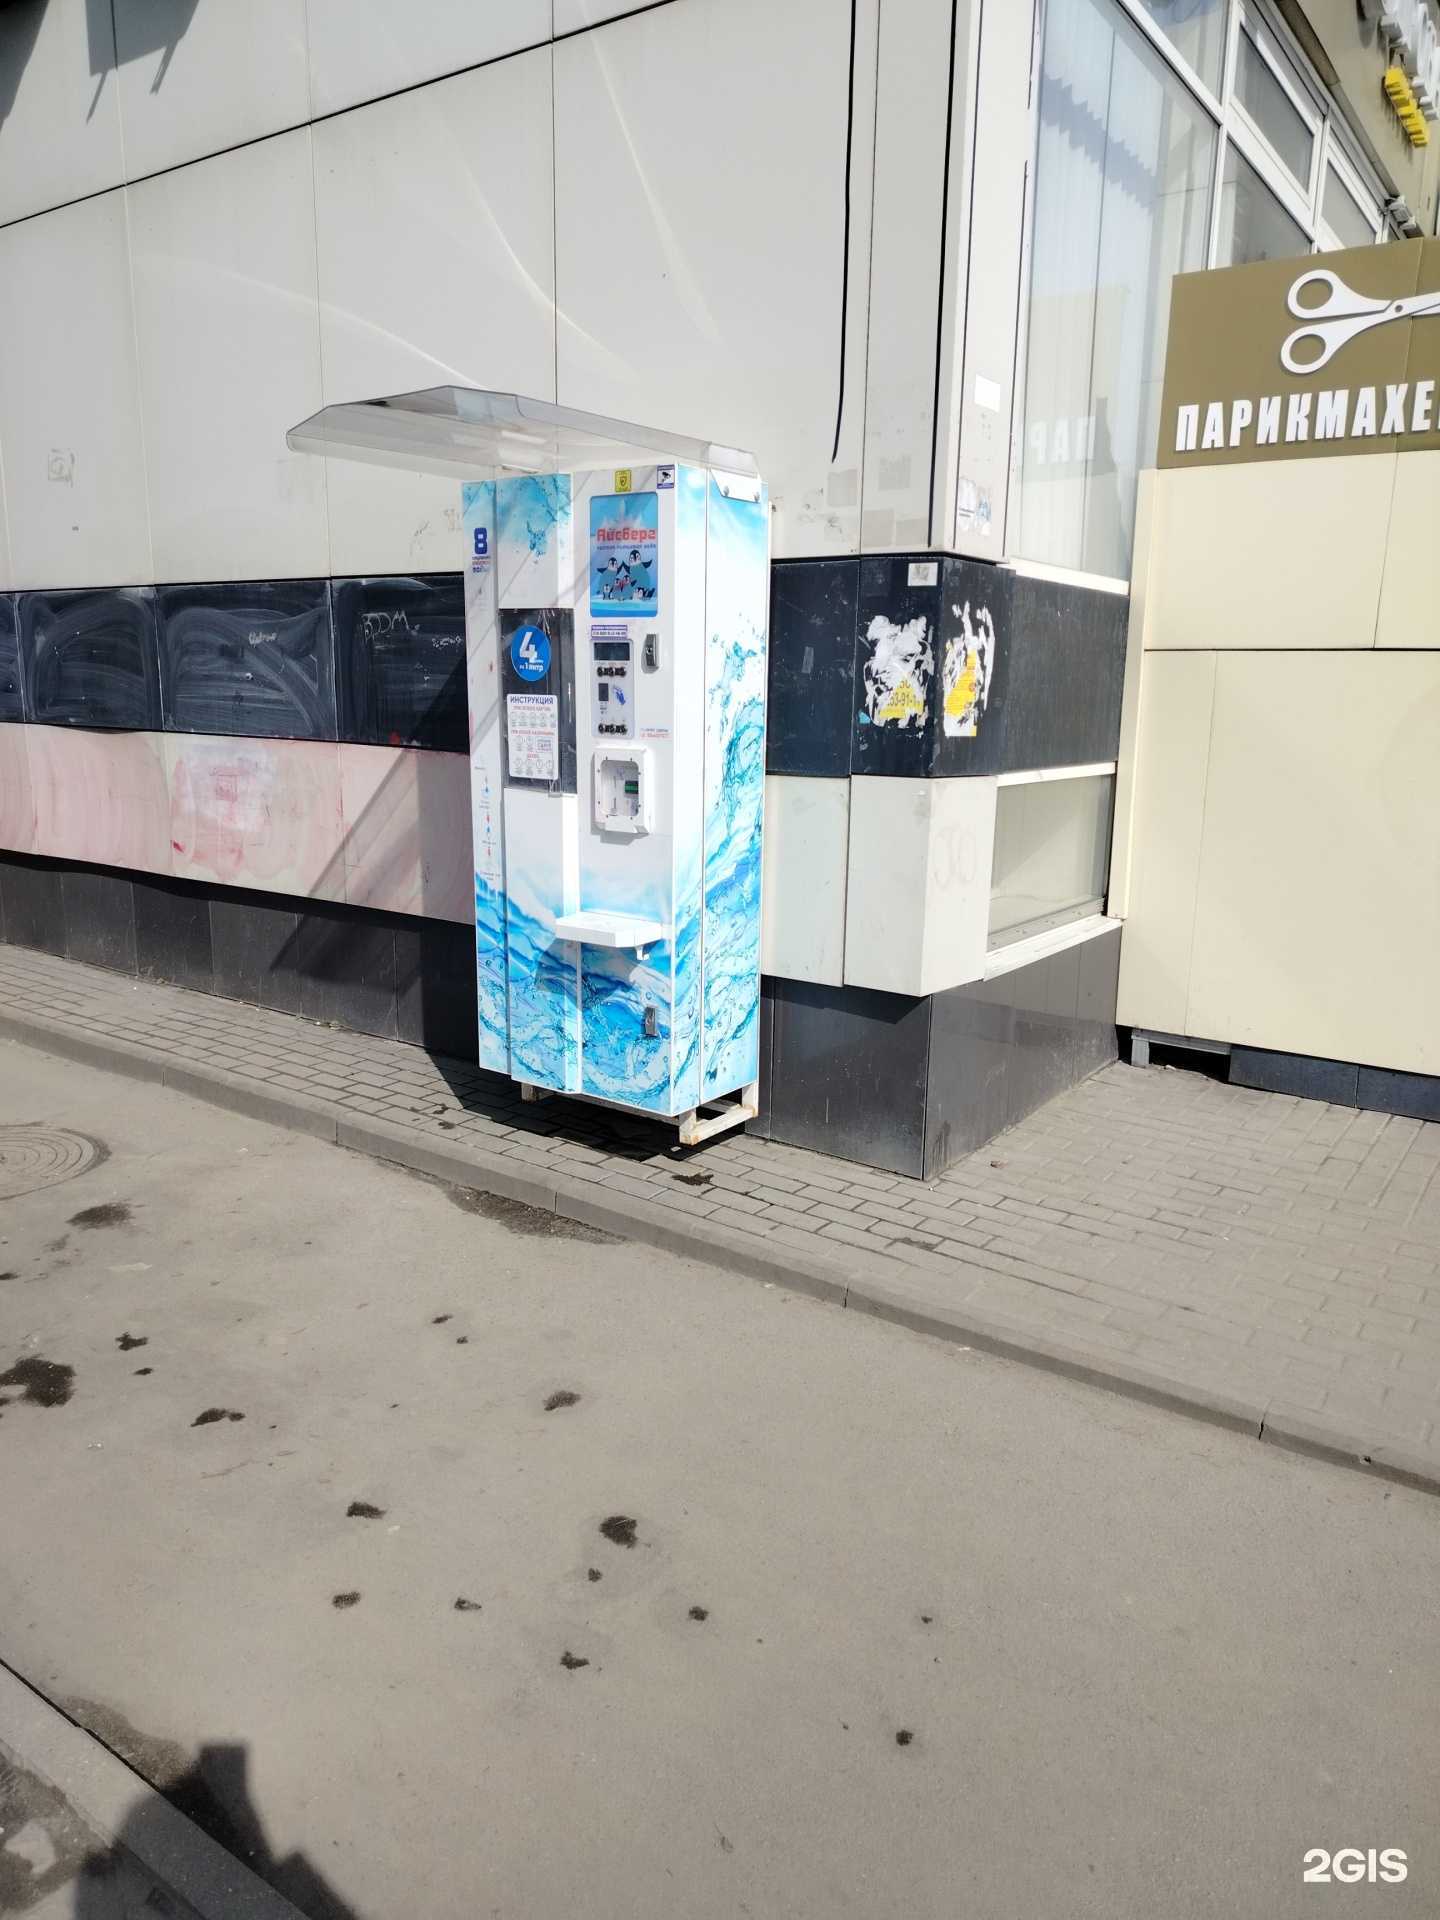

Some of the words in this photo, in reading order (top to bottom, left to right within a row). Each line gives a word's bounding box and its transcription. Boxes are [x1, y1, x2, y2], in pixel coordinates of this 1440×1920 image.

[1175, 380, 1440, 452] ПАРИКМАХЕ
[474, 527, 487, 555] 8
[597, 527, 656, 542] Айсберг
[519, 631, 538, 663] 4
[510, 695, 554, 706] ИНСТРУКЦИЯ
